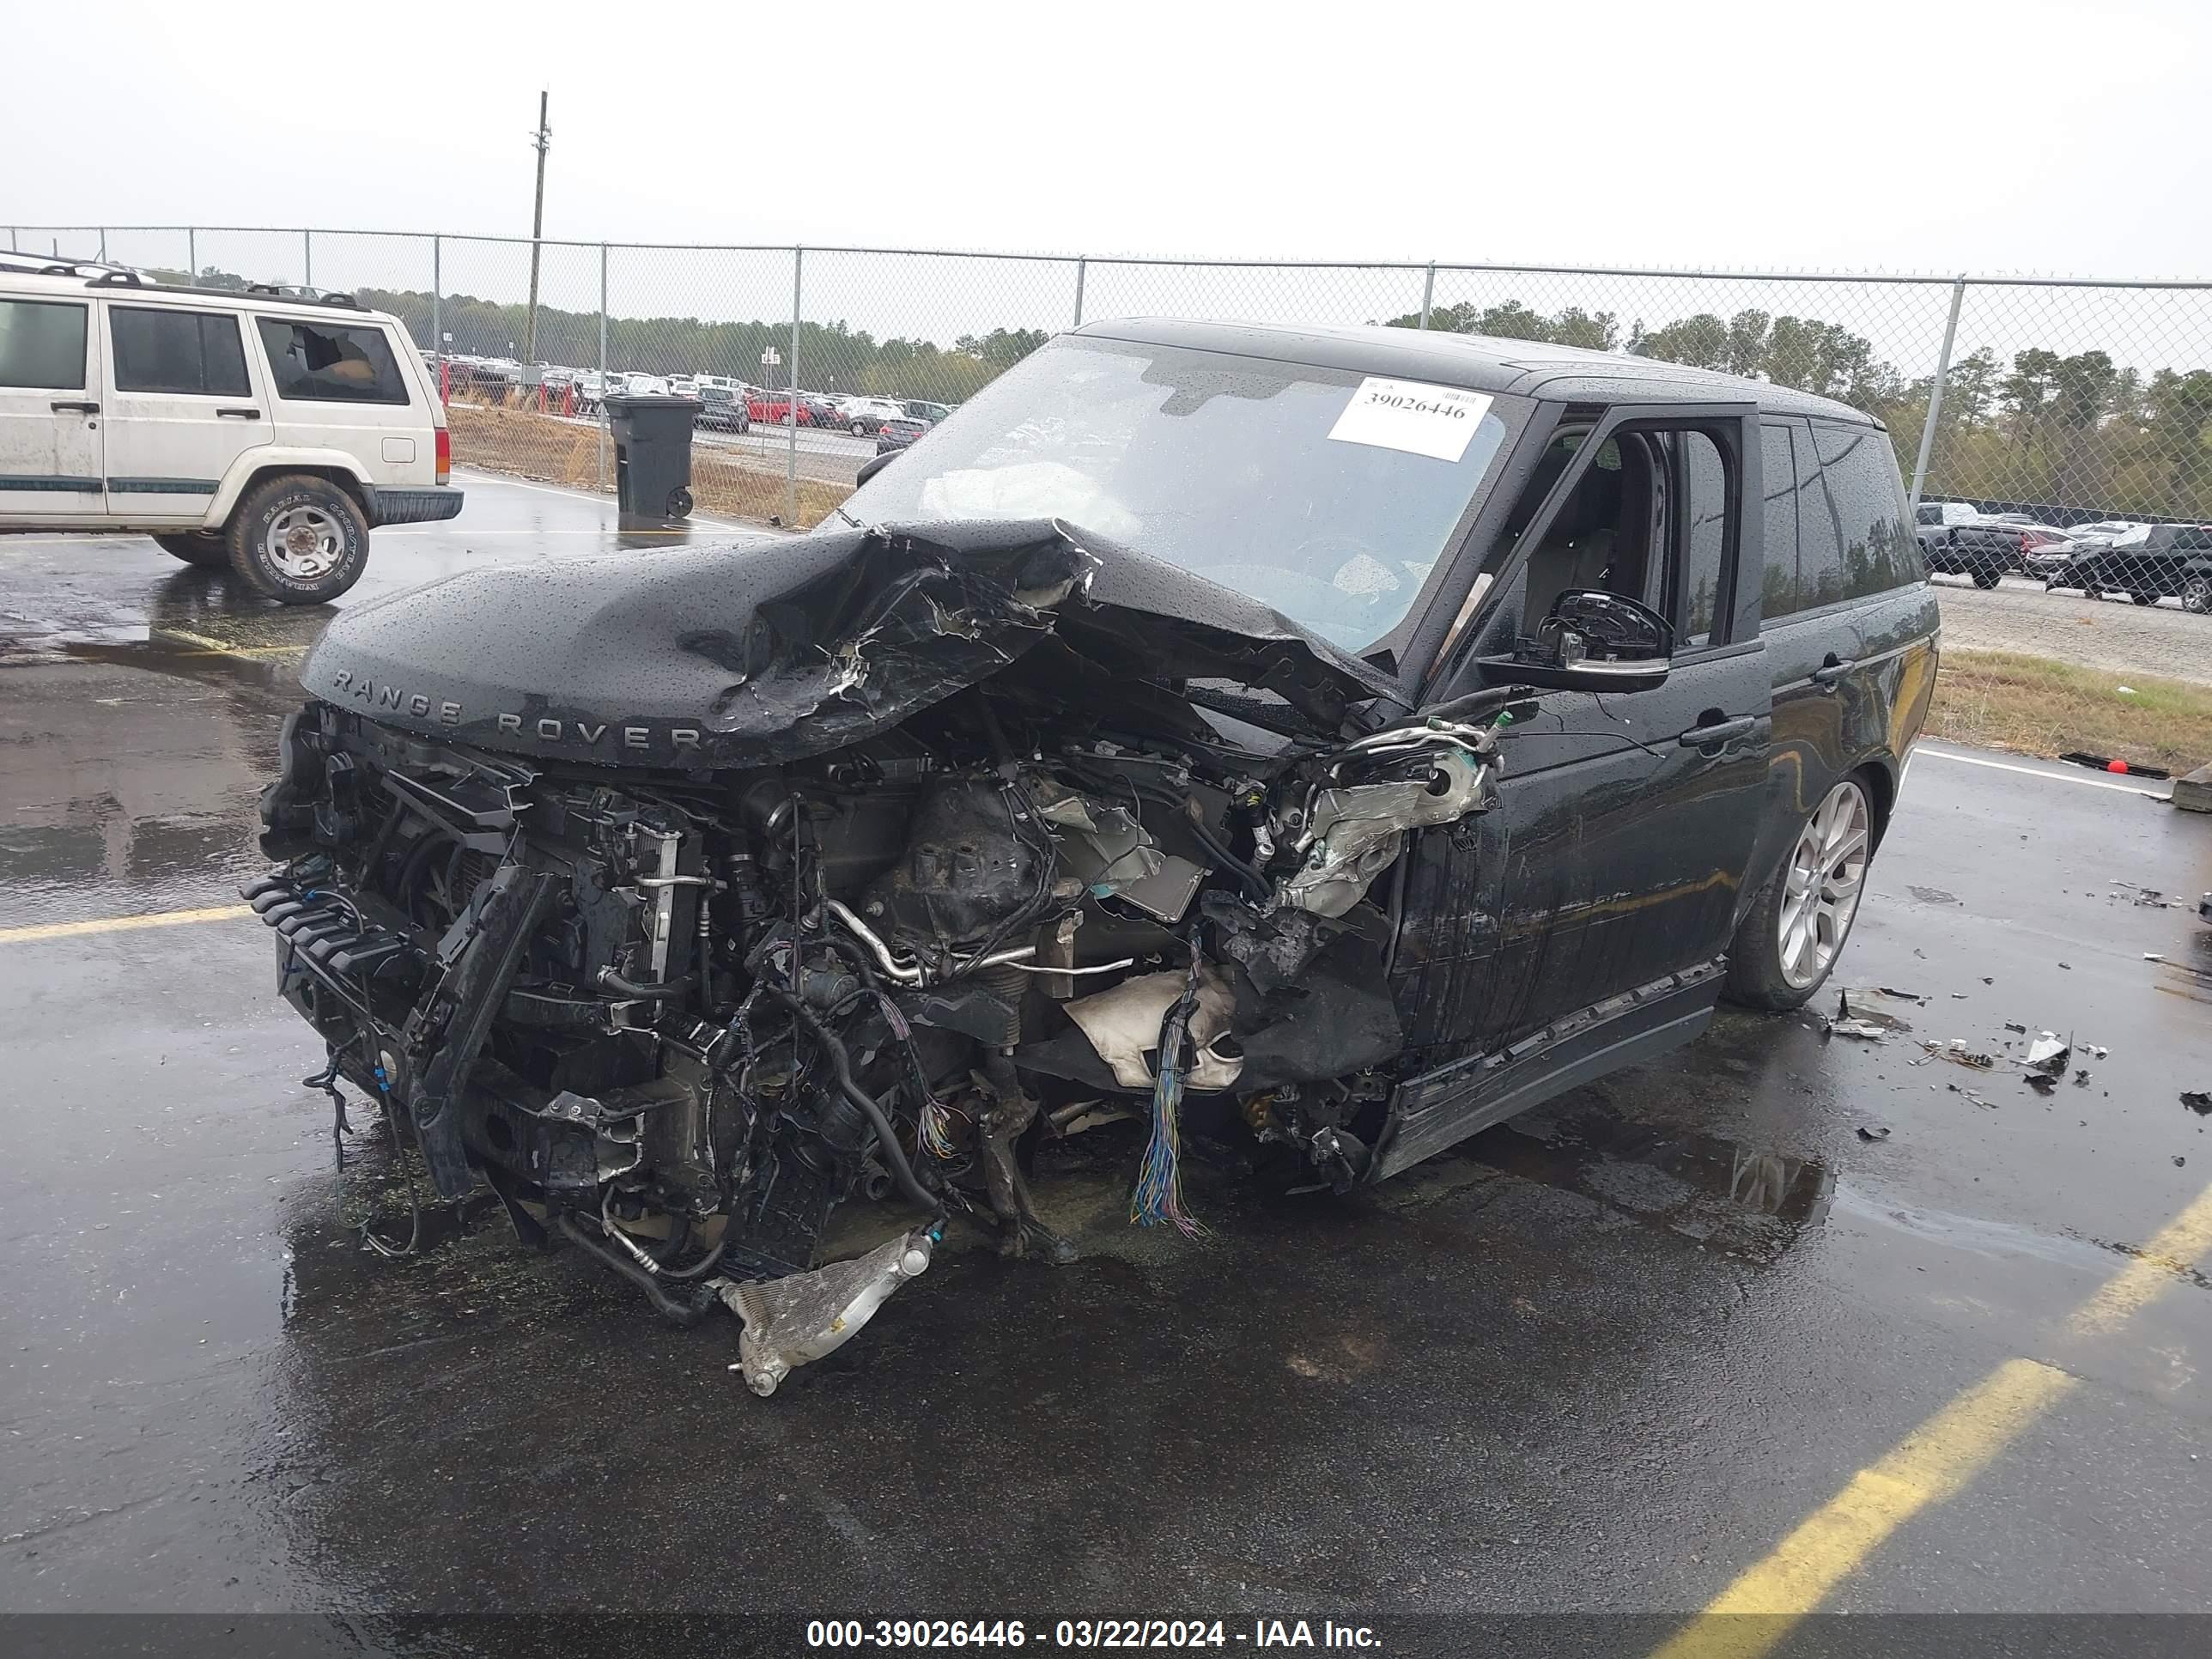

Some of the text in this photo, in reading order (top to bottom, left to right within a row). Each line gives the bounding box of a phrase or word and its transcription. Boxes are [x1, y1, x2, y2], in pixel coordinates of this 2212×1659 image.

[1364, 392, 1467, 419] 39026446
[333, 669, 702, 750] RANGE ROVER
